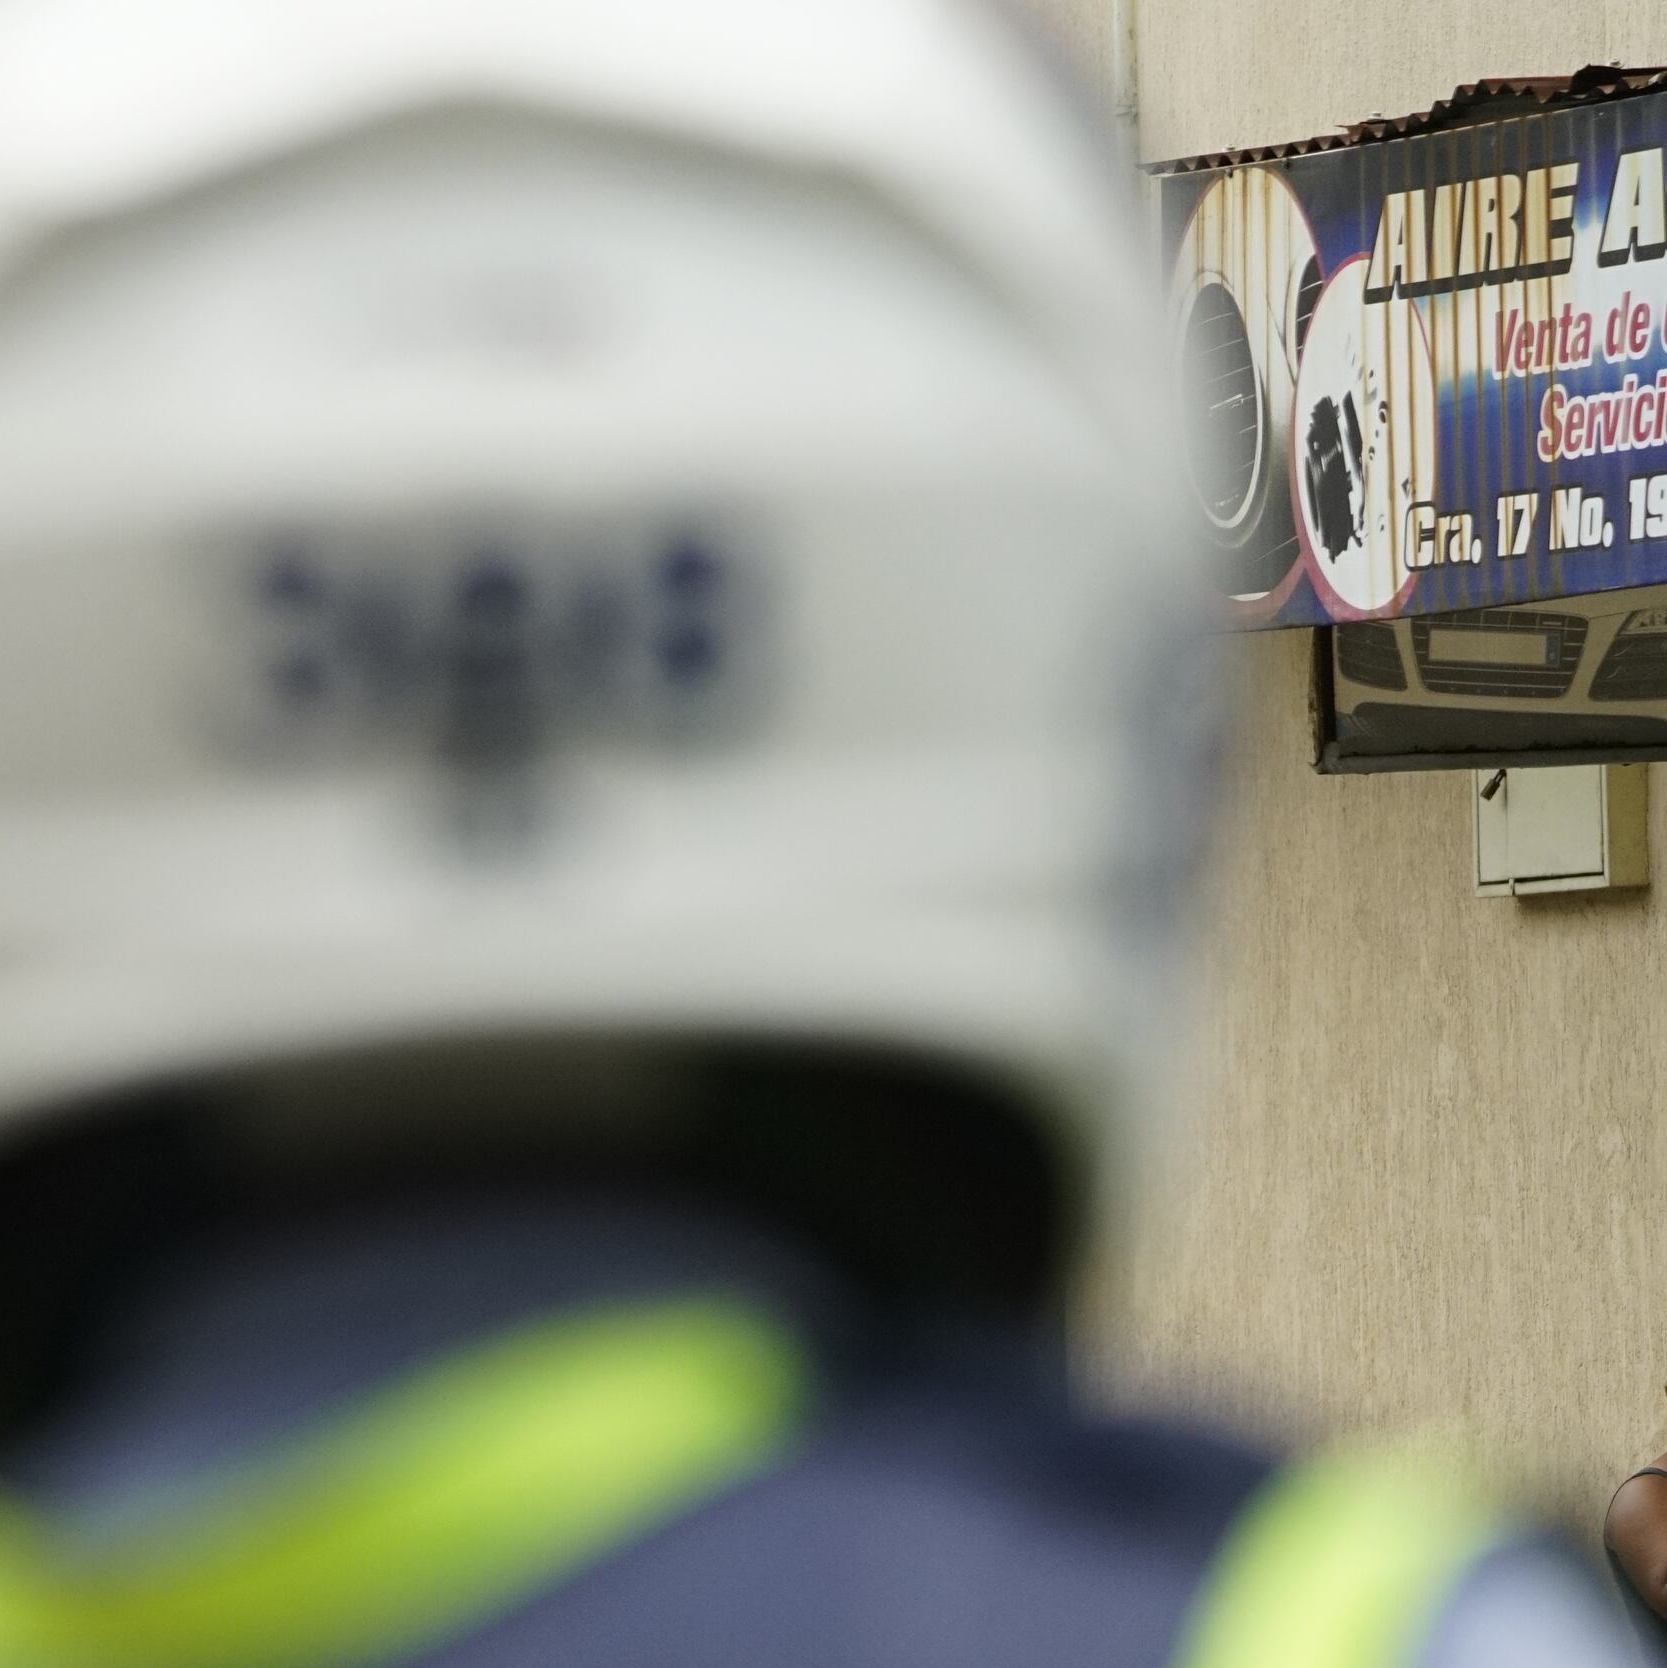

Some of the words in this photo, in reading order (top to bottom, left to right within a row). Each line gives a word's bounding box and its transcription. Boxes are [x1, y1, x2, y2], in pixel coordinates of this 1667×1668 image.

[1365, 163, 1579, 298] AIRE
[1494, 302, 1592, 376] Venta
[1606, 291, 1651, 360] de
[1408, 504, 1482, 567] Cra.
[1497, 493, 1538, 557] 17
[1549, 486, 1614, 549] No.
